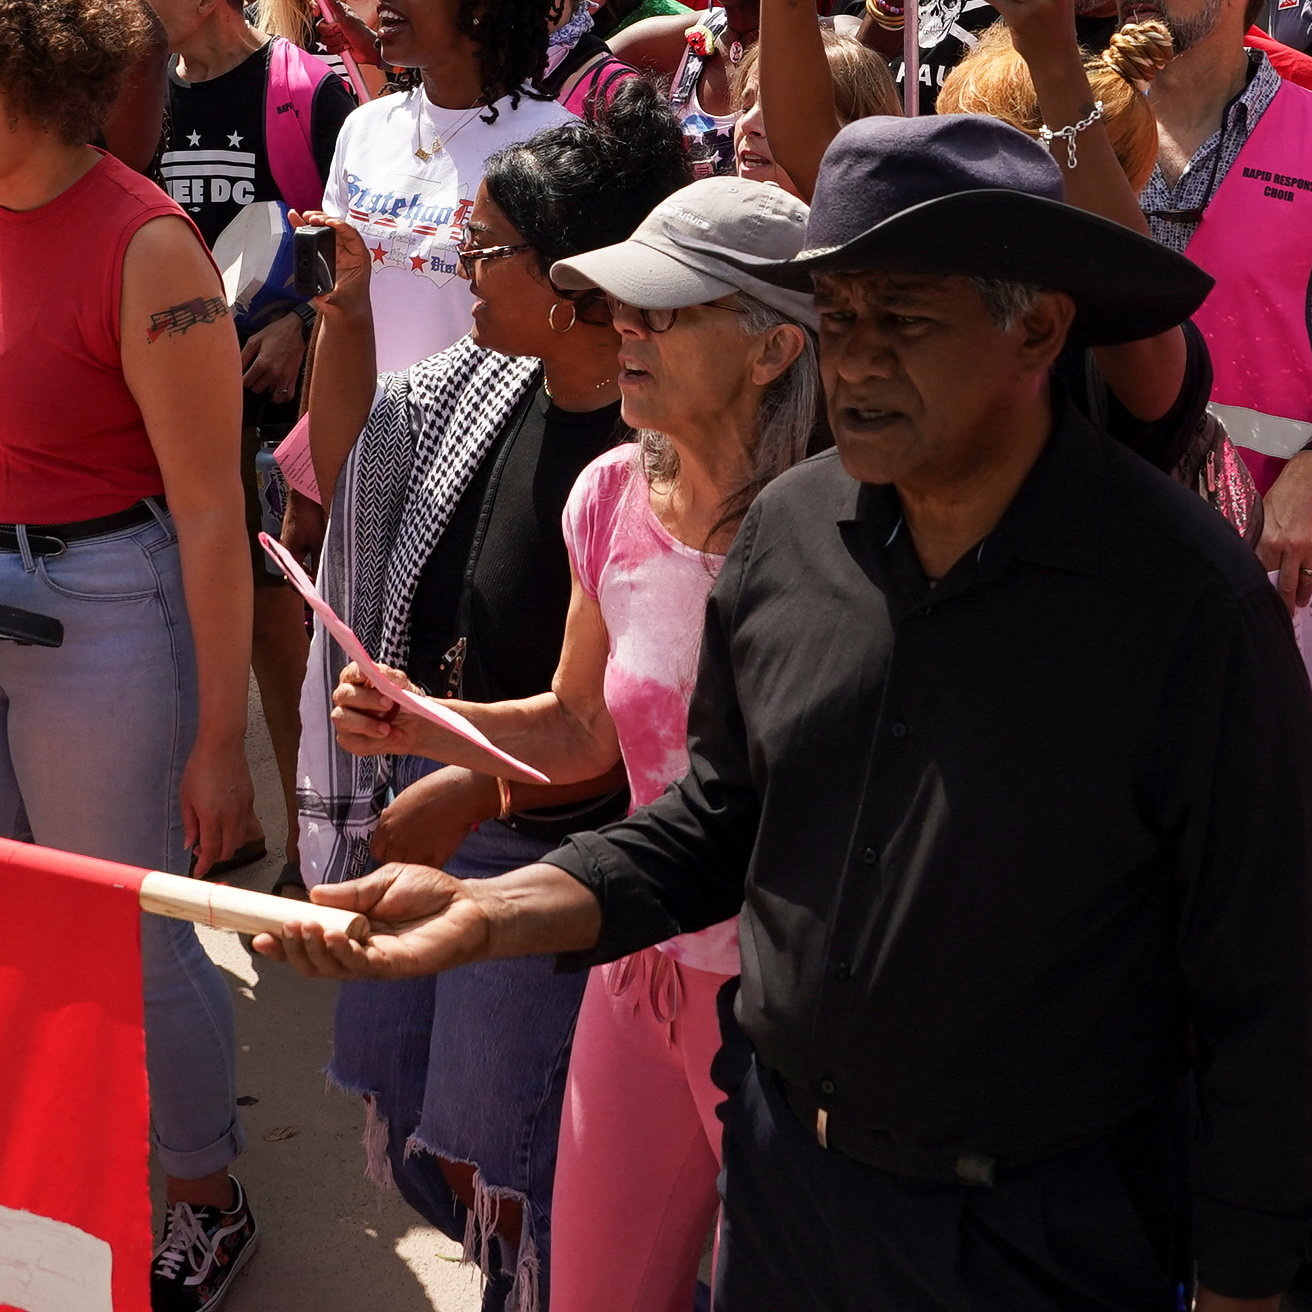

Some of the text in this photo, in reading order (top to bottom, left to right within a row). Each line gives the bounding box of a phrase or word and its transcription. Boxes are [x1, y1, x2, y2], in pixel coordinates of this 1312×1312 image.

[1242, 166, 1272, 182] RAPID
[210, 178, 255, 205] DC
[1263, 186, 1295, 202] CHOIR
